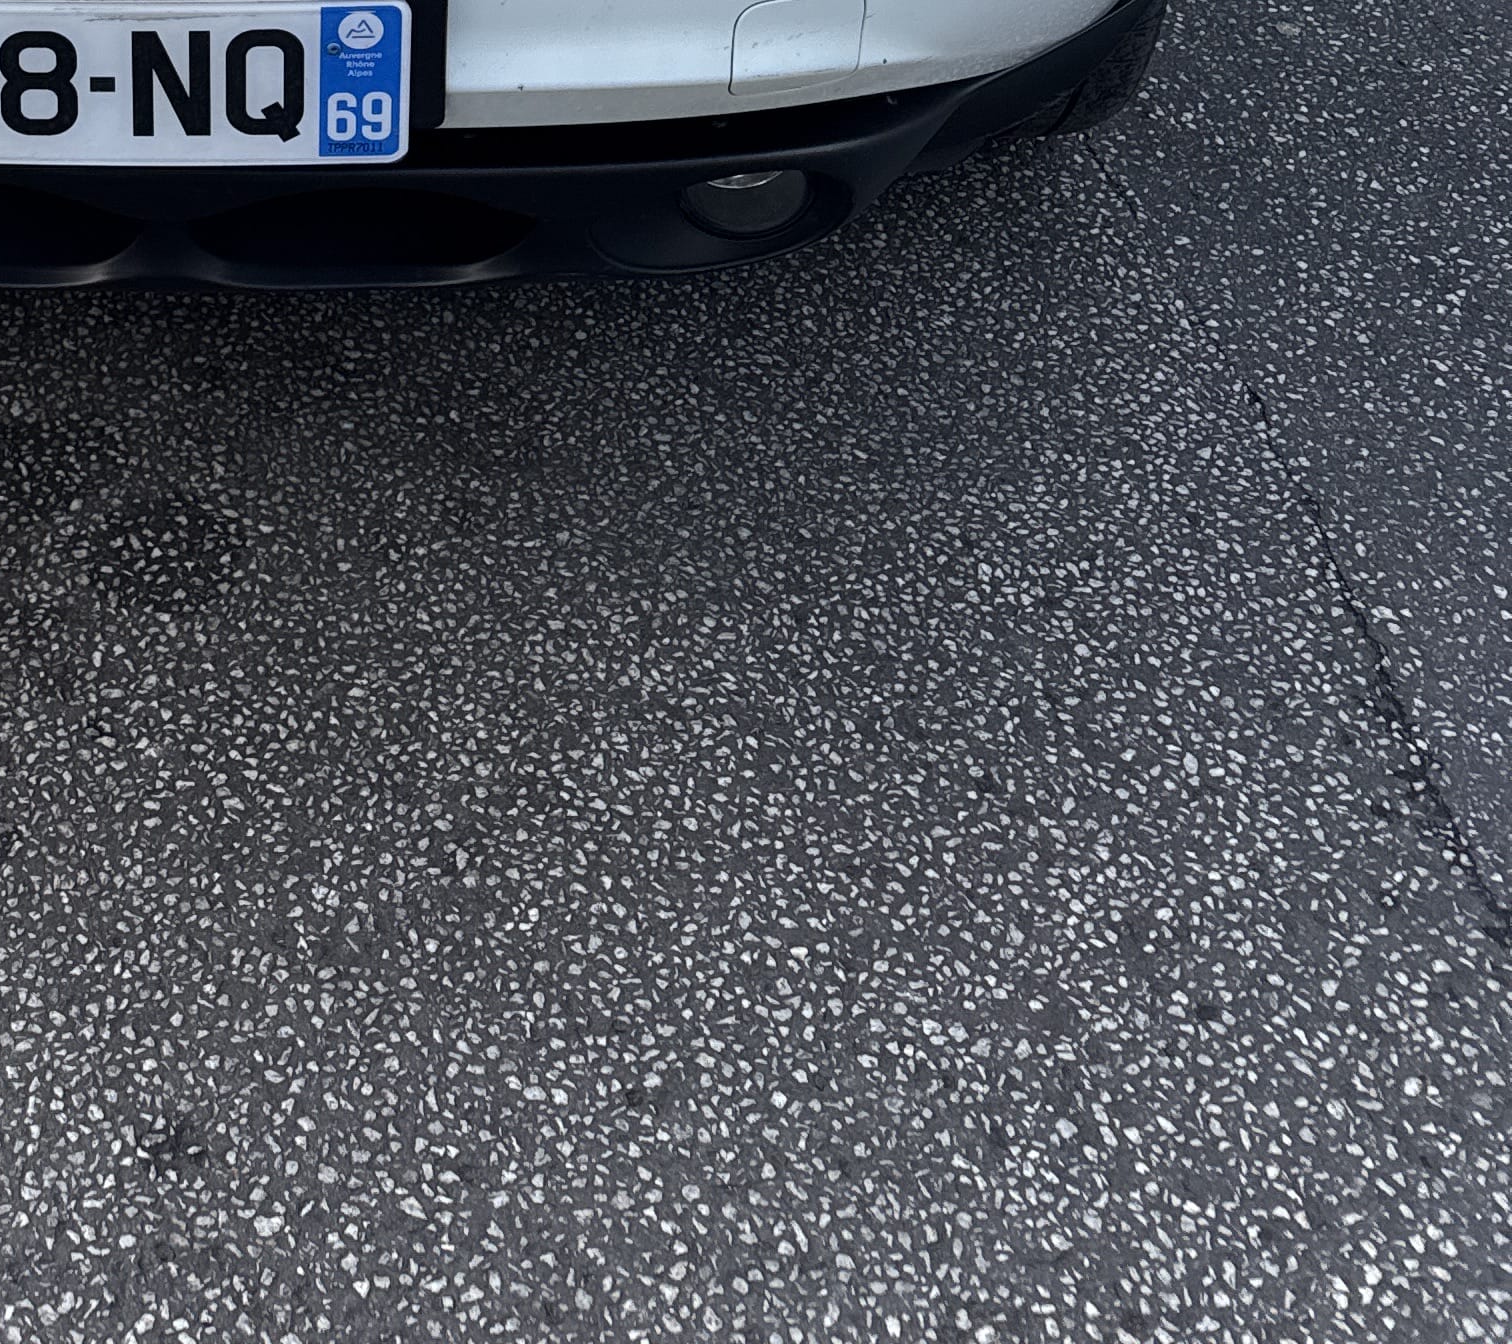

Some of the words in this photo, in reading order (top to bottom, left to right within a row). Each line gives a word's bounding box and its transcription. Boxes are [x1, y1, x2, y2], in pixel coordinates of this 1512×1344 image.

[338, 51, 383, 60] Auvergne
[346, 60, 376, 68] Rhône
[347, 69, 374, 78] Alpes
[326, 91, 393, 141] 69
